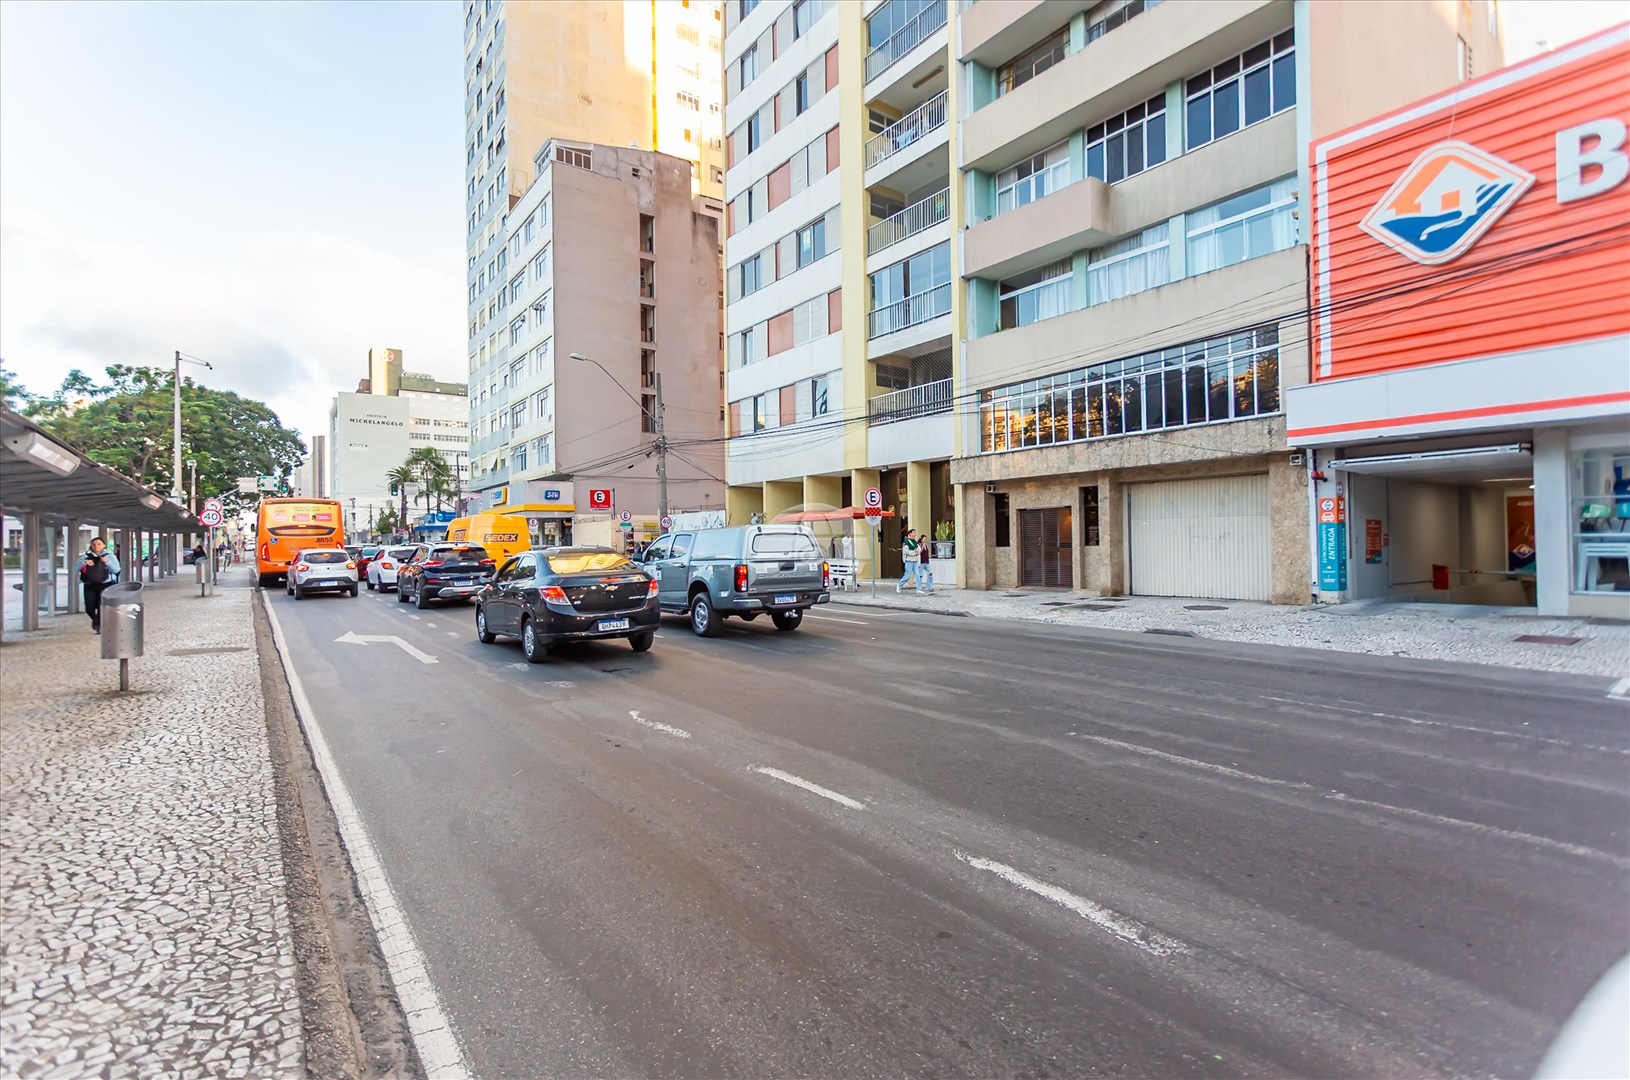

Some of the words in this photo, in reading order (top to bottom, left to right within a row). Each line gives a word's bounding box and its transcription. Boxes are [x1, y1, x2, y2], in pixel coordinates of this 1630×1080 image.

[1556, 117, 1629, 204] B
[350, 418, 403, 426] MICHELANGELO
[596, 492, 602, 501] E
[870, 491, 876, 503] E
[204, 512, 218, 521] 40
[484, 534, 517, 542] SEDEX
[1328, 527, 1336, 560] ENTRADA
